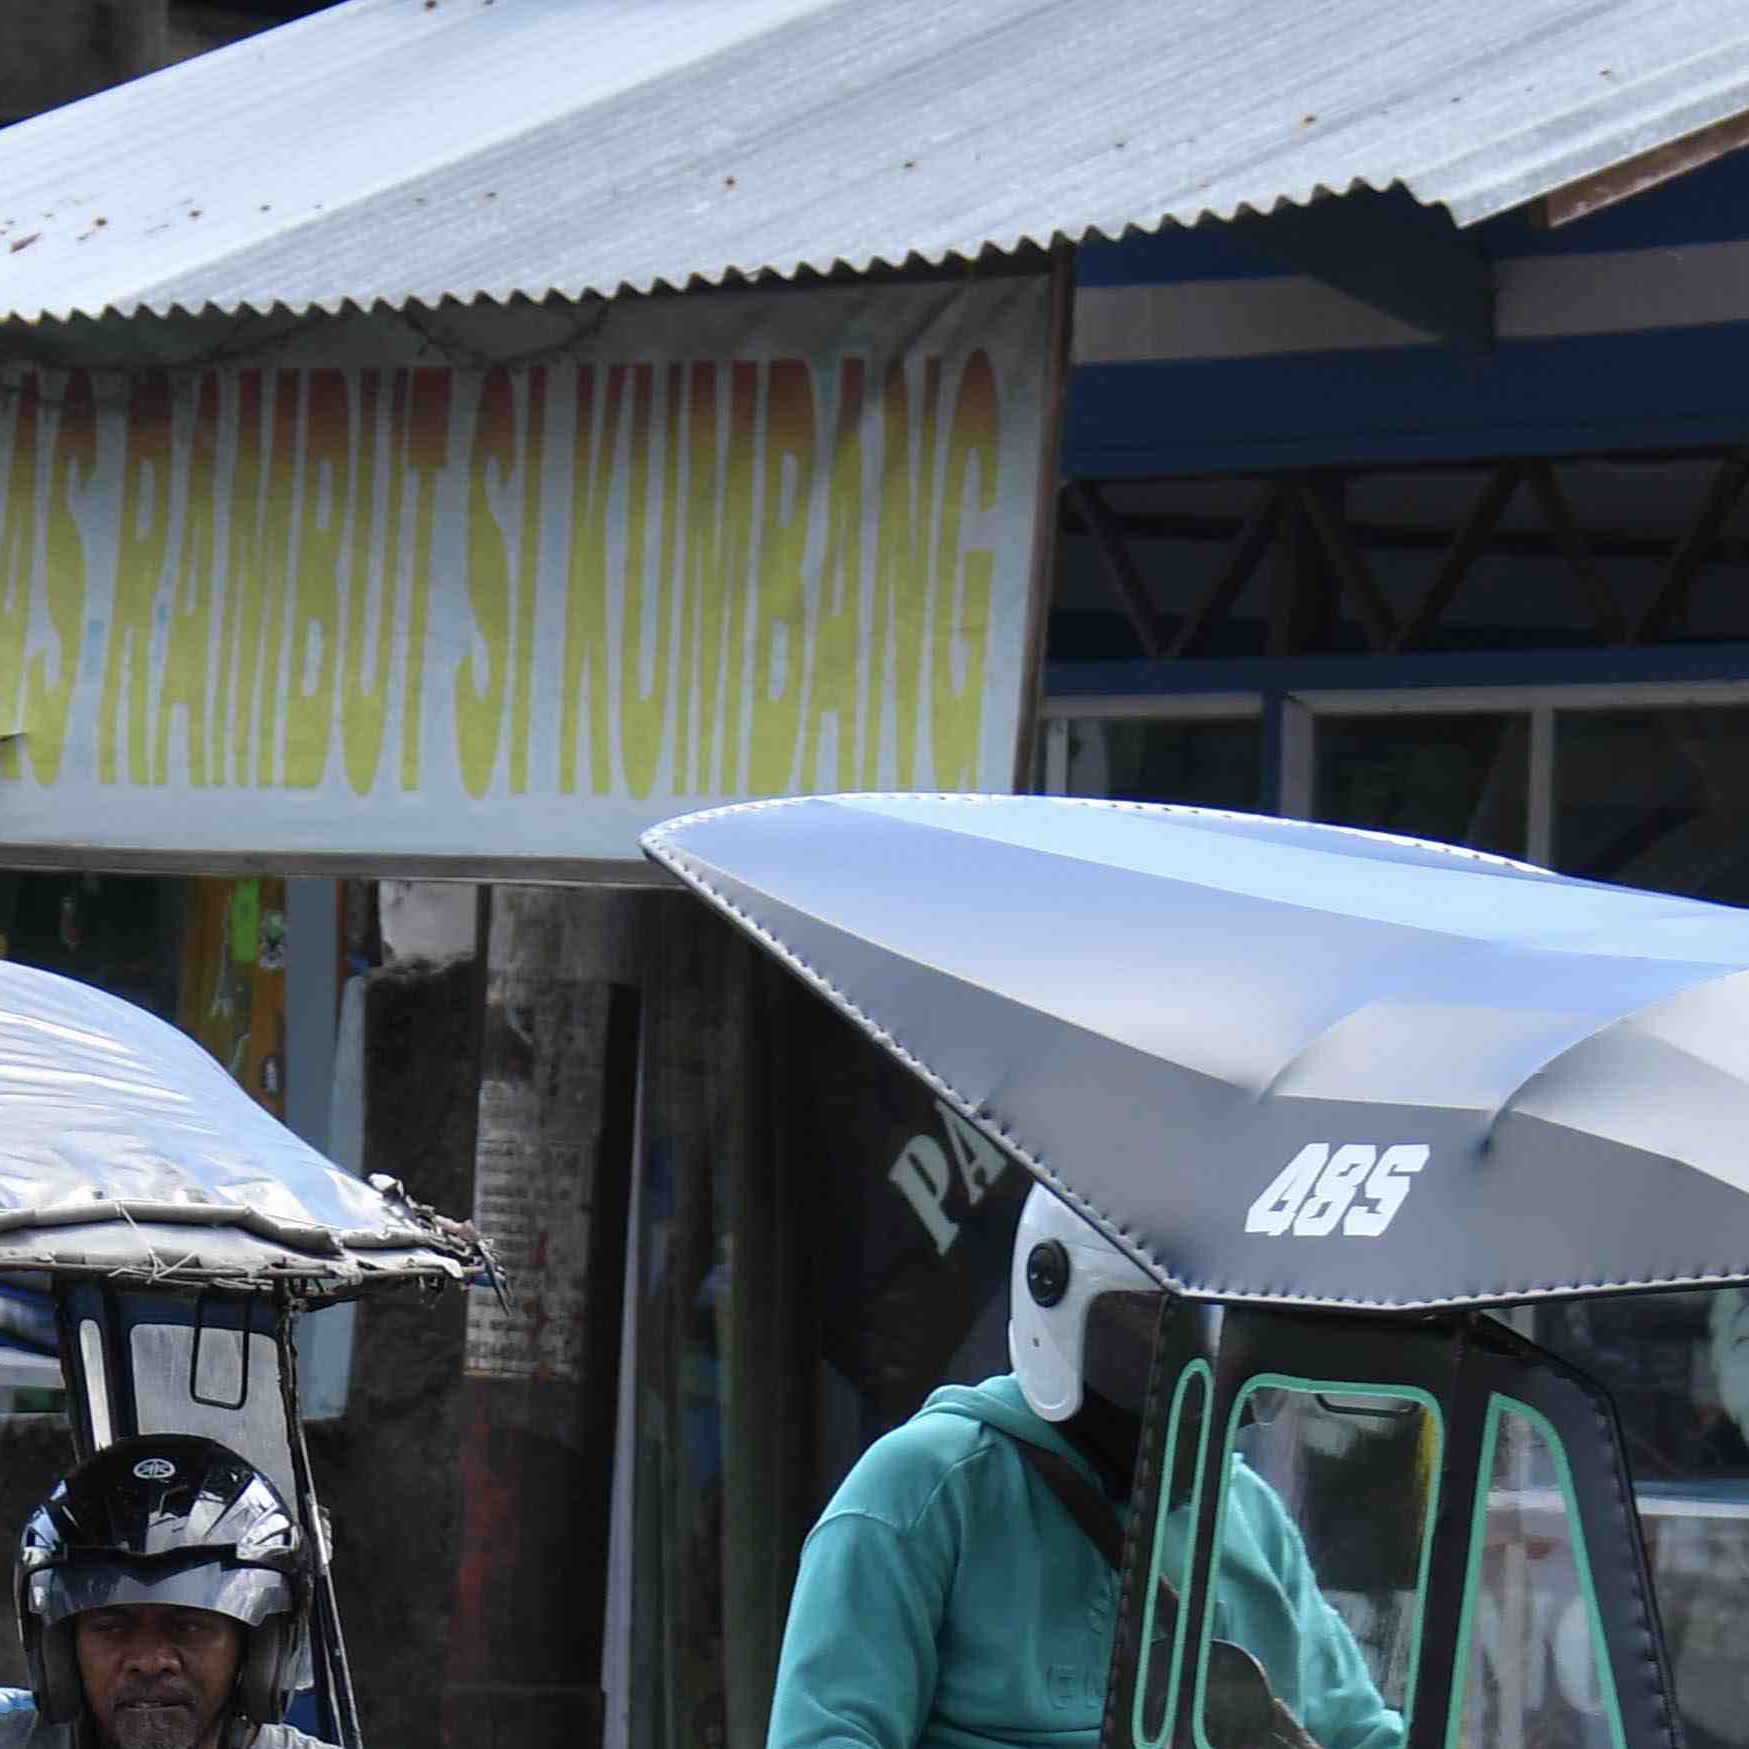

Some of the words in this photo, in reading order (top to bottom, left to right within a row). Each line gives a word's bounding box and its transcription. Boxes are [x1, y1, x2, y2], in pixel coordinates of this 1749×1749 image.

[97, 364, 450, 798] RAMBUT
[454, 356, 547, 800] SI
[556, 346, 1001, 802] KUMBANG
